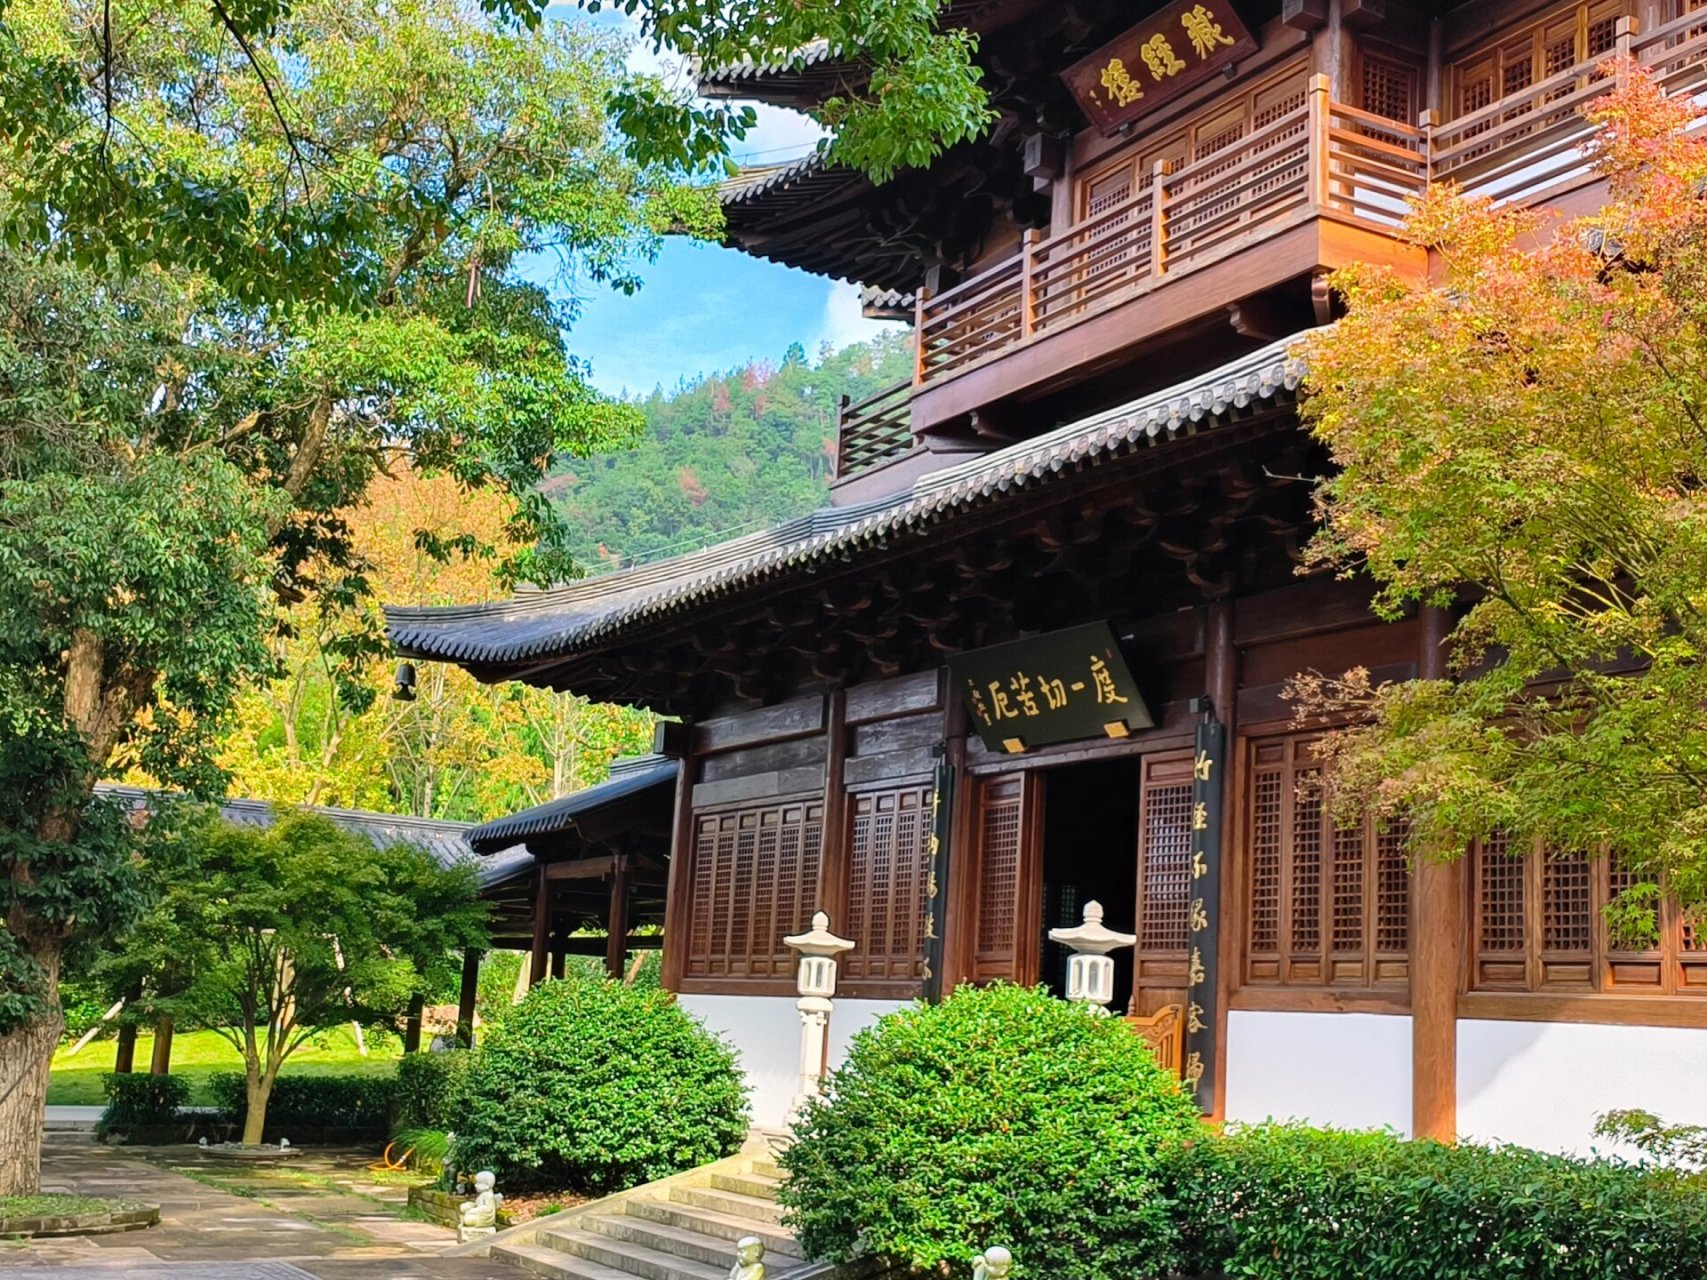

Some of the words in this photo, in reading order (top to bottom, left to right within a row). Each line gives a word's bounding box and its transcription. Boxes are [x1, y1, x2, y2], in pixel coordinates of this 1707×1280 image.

[1101, 4, 1235, 107] 藏經樓
[988, 655, 1128, 720] 度一切苦厄
